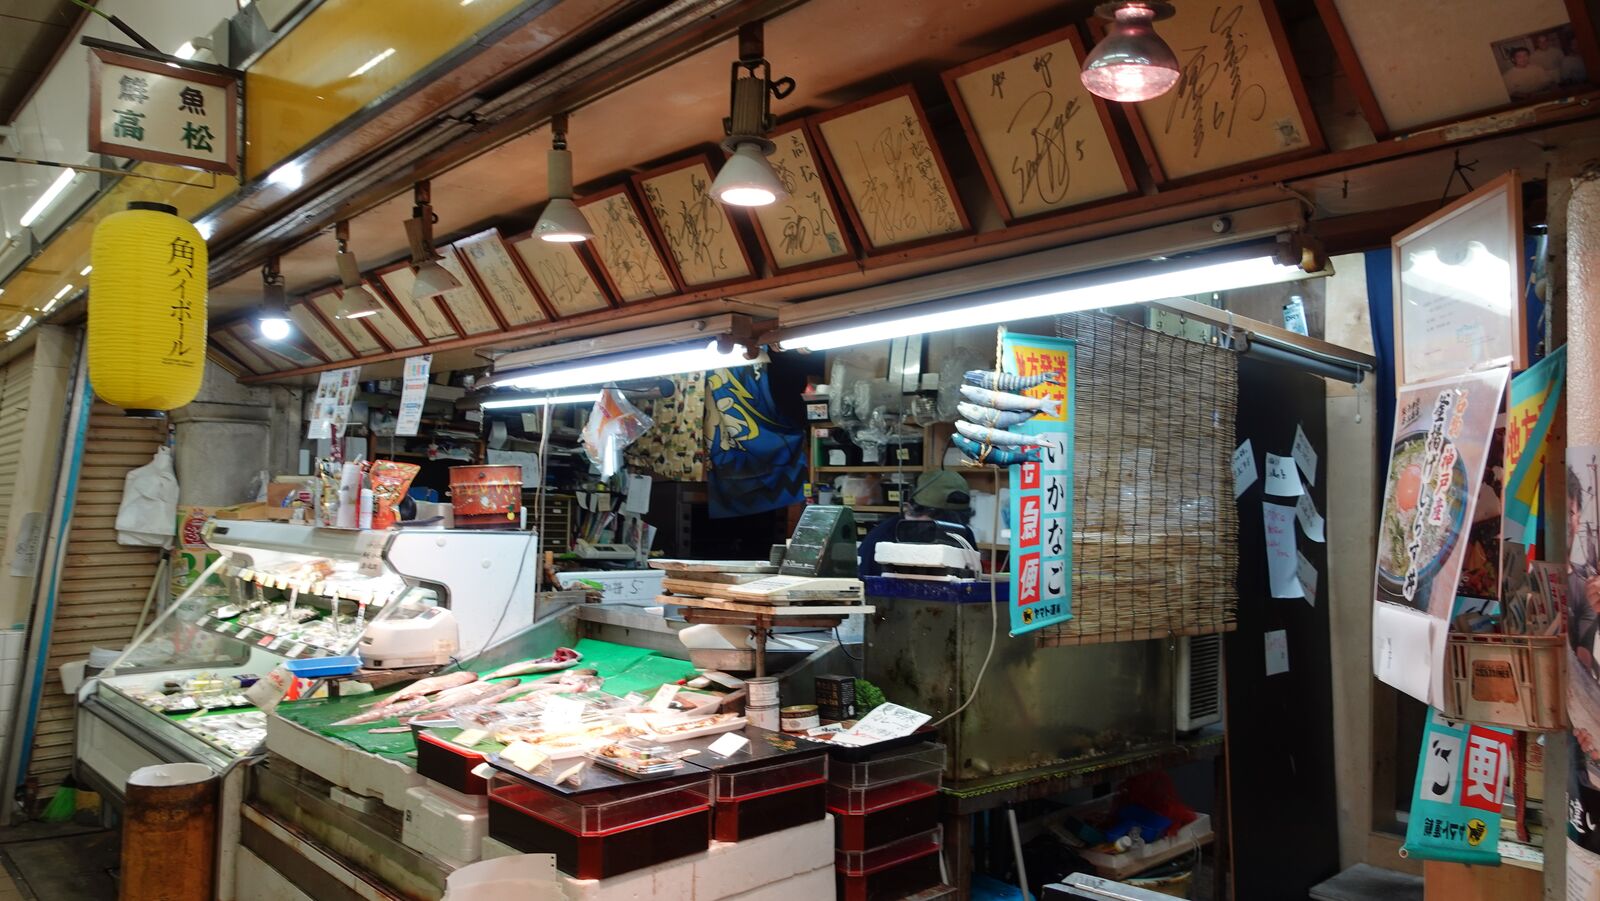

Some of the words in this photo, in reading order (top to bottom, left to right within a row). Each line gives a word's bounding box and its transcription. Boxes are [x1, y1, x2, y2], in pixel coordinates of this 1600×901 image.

[117, 74, 206, 116] 鮮魚
[112, 108, 216, 153] 高松
[167, 236, 195, 357] 角ハイボール
